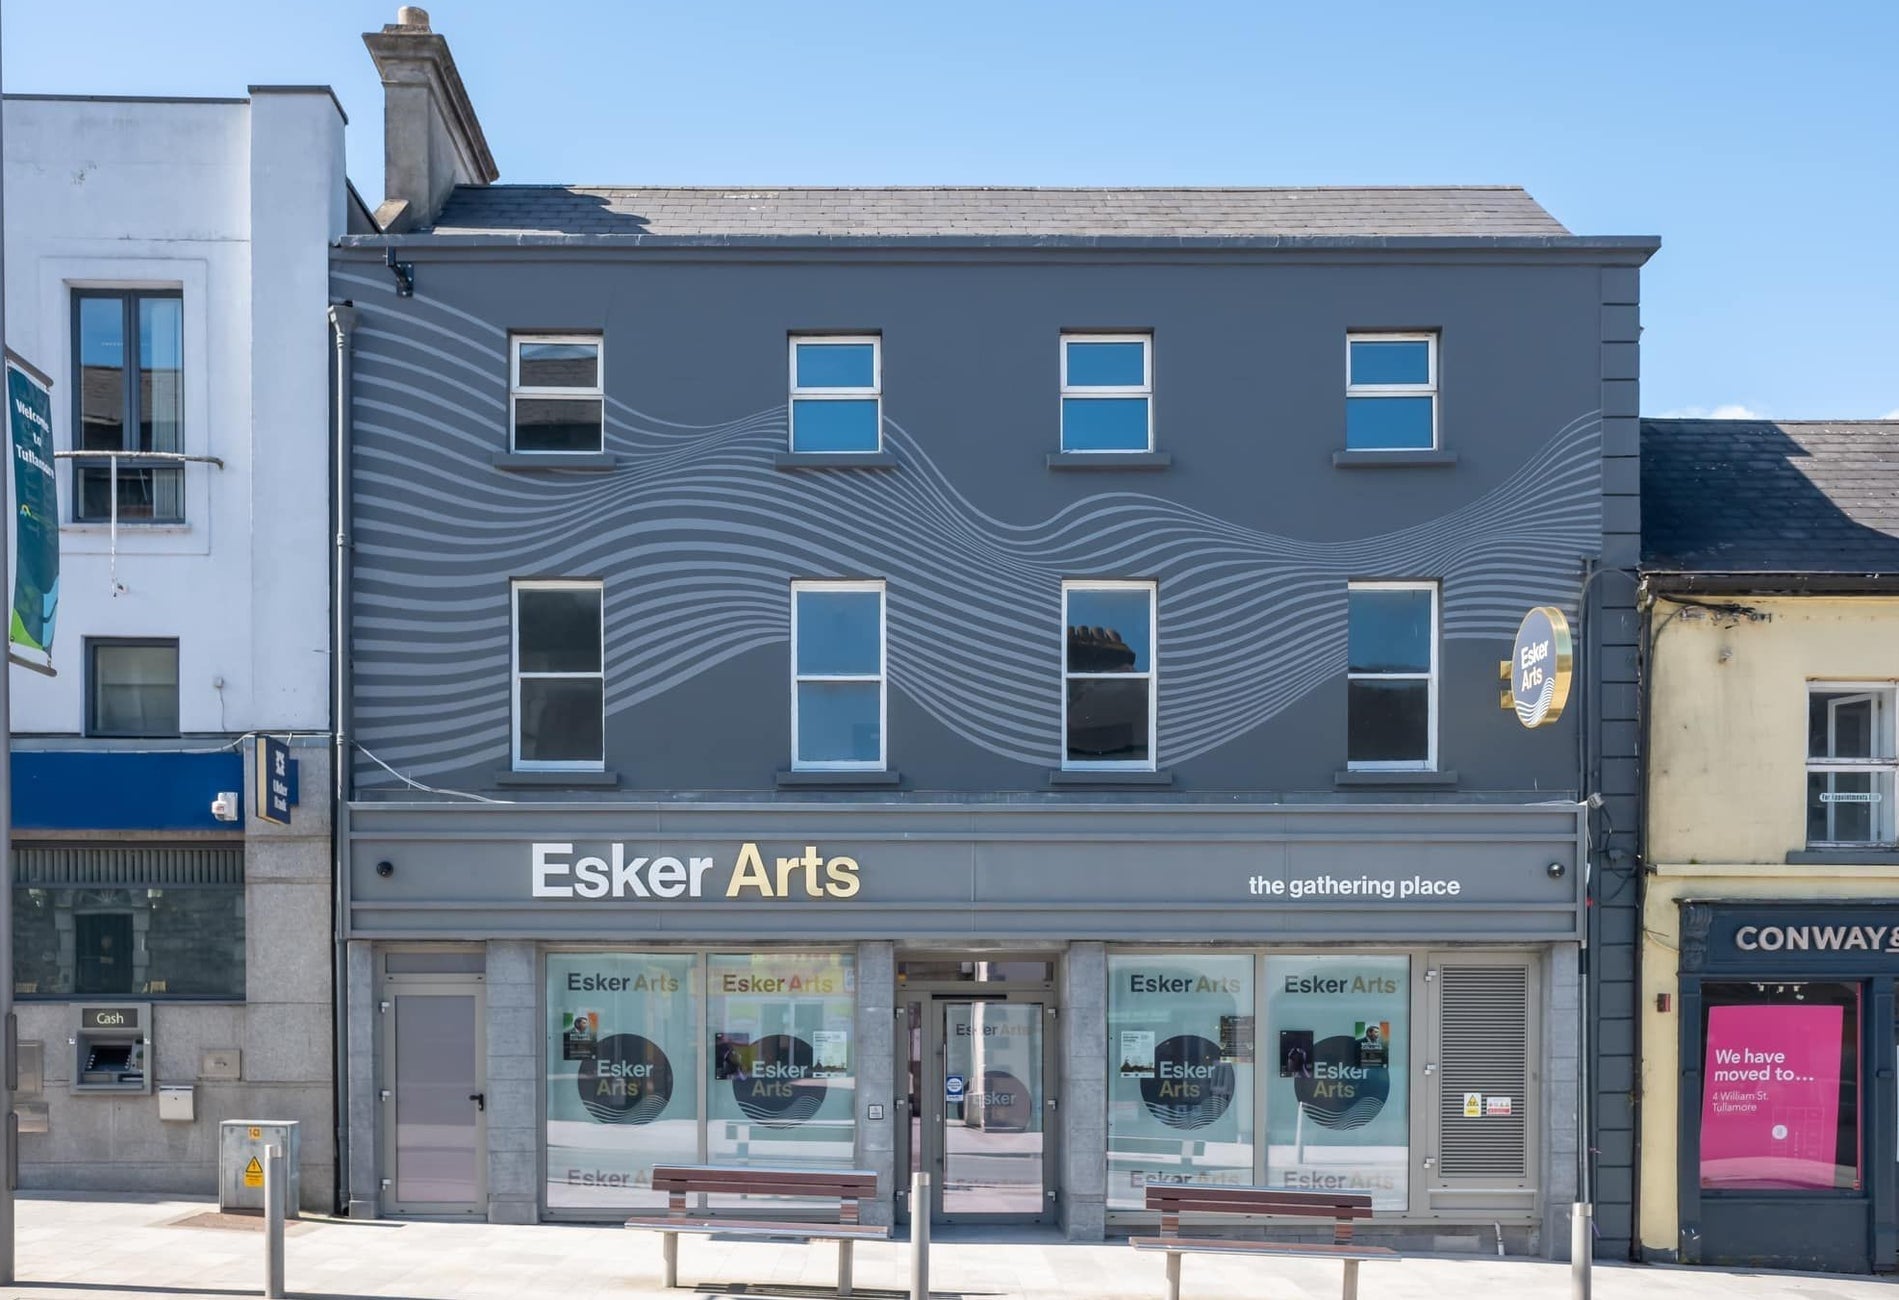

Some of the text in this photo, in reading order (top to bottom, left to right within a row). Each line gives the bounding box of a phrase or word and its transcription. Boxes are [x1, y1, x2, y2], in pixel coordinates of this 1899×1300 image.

[15, 398, 50, 433] Welcome
[32, 432, 42, 447] to
[1521, 640, 1549, 669] Esker
[1521, 666, 1543, 692] Arts
[532, 842, 861, 898] Esker Arts
[1249, 875, 1461, 898] the gathering place
[1735, 926, 1888, 951] CONWAY
[567, 973, 679, 992] Esker Arts
[723, 974, 834, 993] Esker Arts
[1131, 975, 1241, 993] Esker Arts
[1285, 975, 1397, 994] Esker Arts
[96, 1012, 124, 1026] Cash
[1714, 1048, 1786, 1064] We have
[597, 1060, 654, 1077] Esker
[752, 1061, 808, 1079] Esker
[1160, 1061, 1216, 1079] Esker
[1314, 1062, 1369, 1079] Esker
[1714, 1066, 1770, 1082] moved
[596, 1080, 639, 1096] Arts
[752, 1081, 792, 1097] Arts
[1159, 1081, 1200, 1098] Arts
[1313, 1082, 1356, 1099] Arts
[1712, 1091, 1769, 1101] 4 William St.
[1712, 1102, 1757, 1113] Tullamore
[567, 1169, 629, 1187] Esker
[1284, 1171, 1346, 1189] Esker
